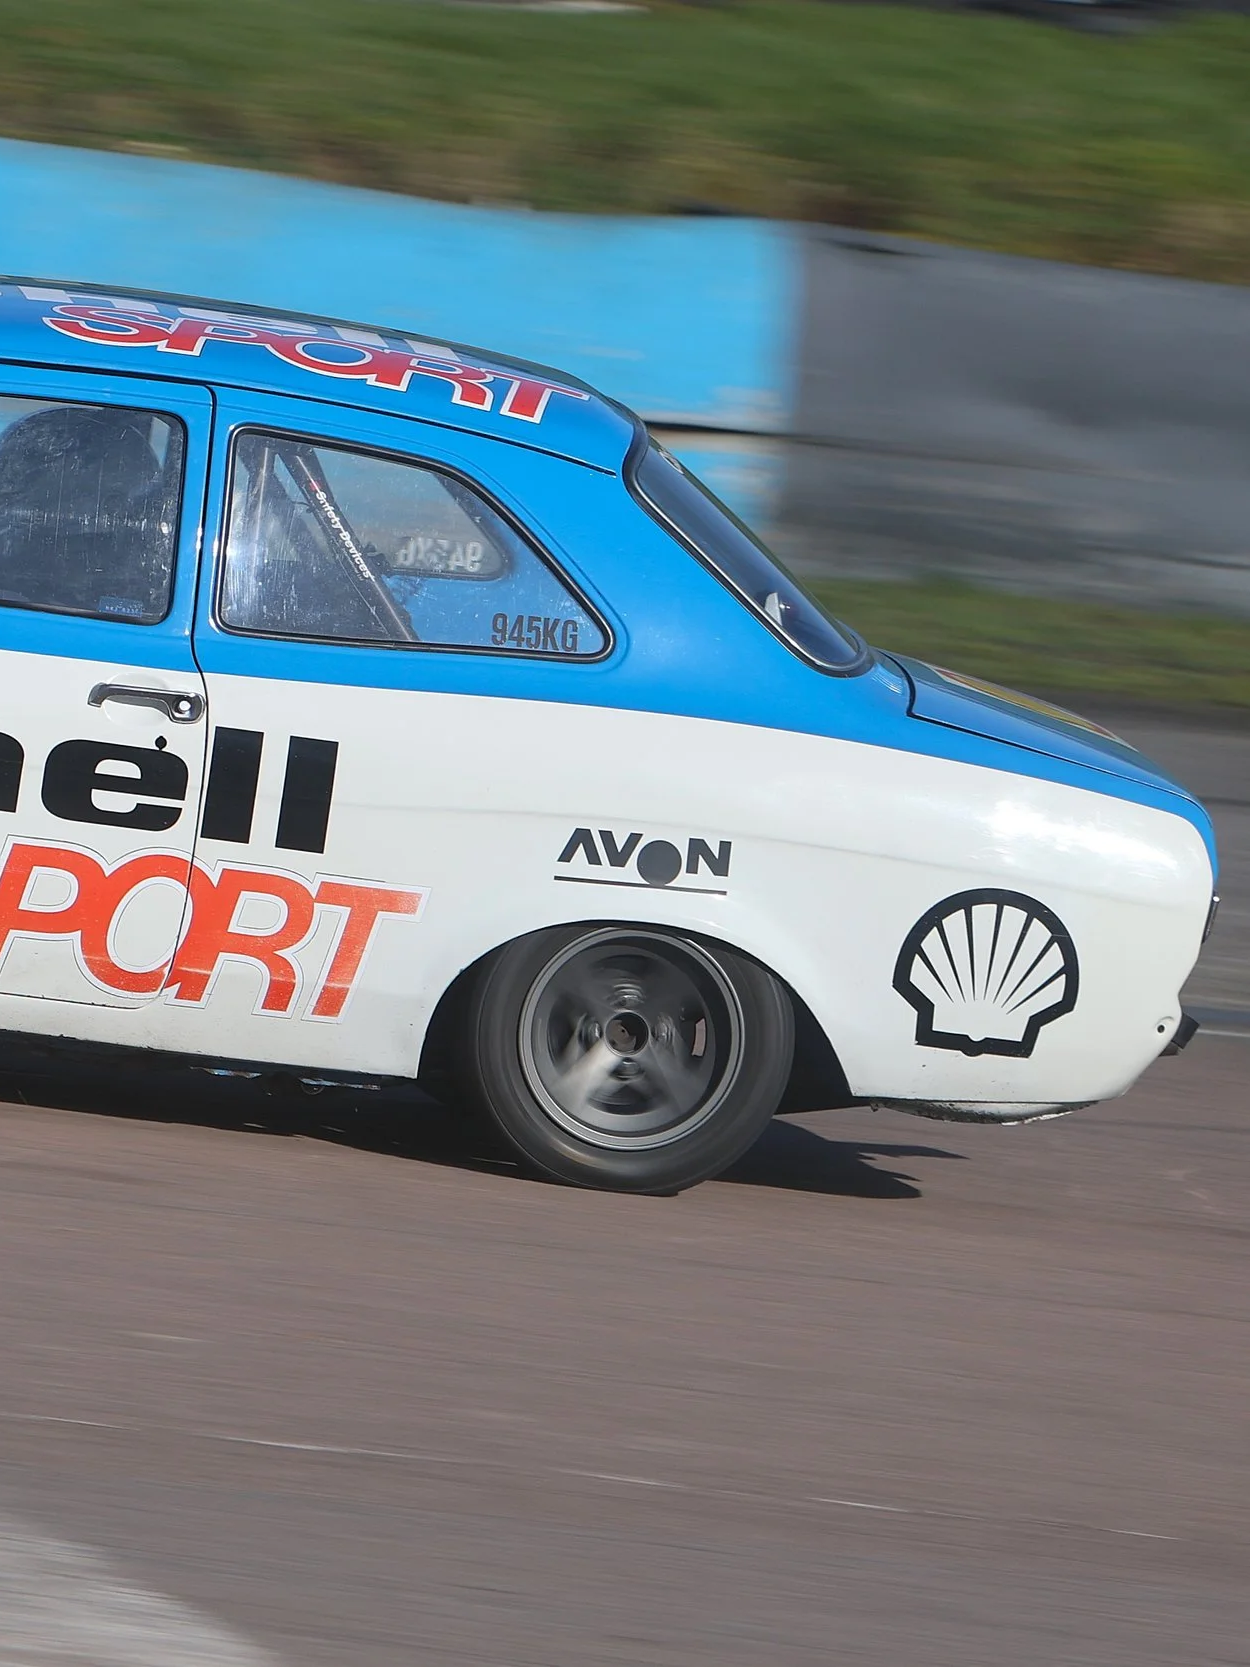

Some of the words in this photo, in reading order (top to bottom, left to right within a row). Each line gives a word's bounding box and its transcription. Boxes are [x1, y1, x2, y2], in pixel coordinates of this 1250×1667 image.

[43, 304, 590, 424] SPORT
[339, 531, 372, 579] Devices
[491, 612, 578, 652] 945KG
[557, 827, 732, 886] AVON
